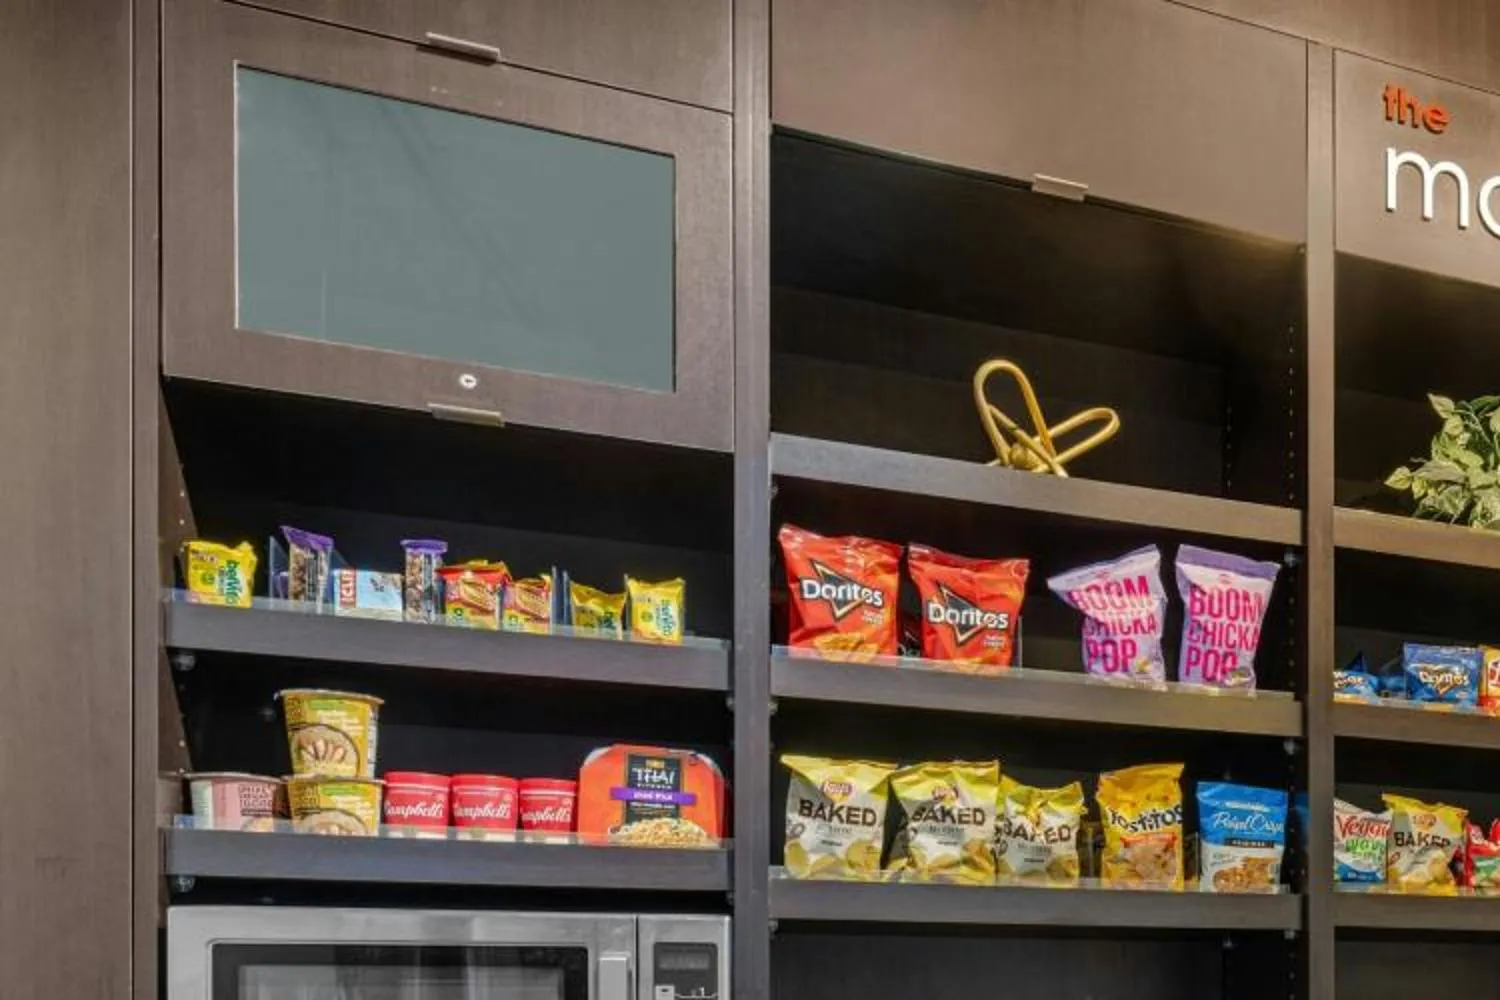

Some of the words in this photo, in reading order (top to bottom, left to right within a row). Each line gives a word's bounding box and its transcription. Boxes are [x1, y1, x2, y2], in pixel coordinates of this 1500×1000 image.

[1382, 83, 1448, 134] the
[800, 578, 883, 607] Doritos
[927, 602, 1009, 630] Doritos
[1086, 639, 1138, 674] POP
[1185, 649, 1239, 683] POP
[632, 768, 676, 785] THAI
[799, 799, 877, 827] BAKED
[910, 806, 987, 826] BAKED
